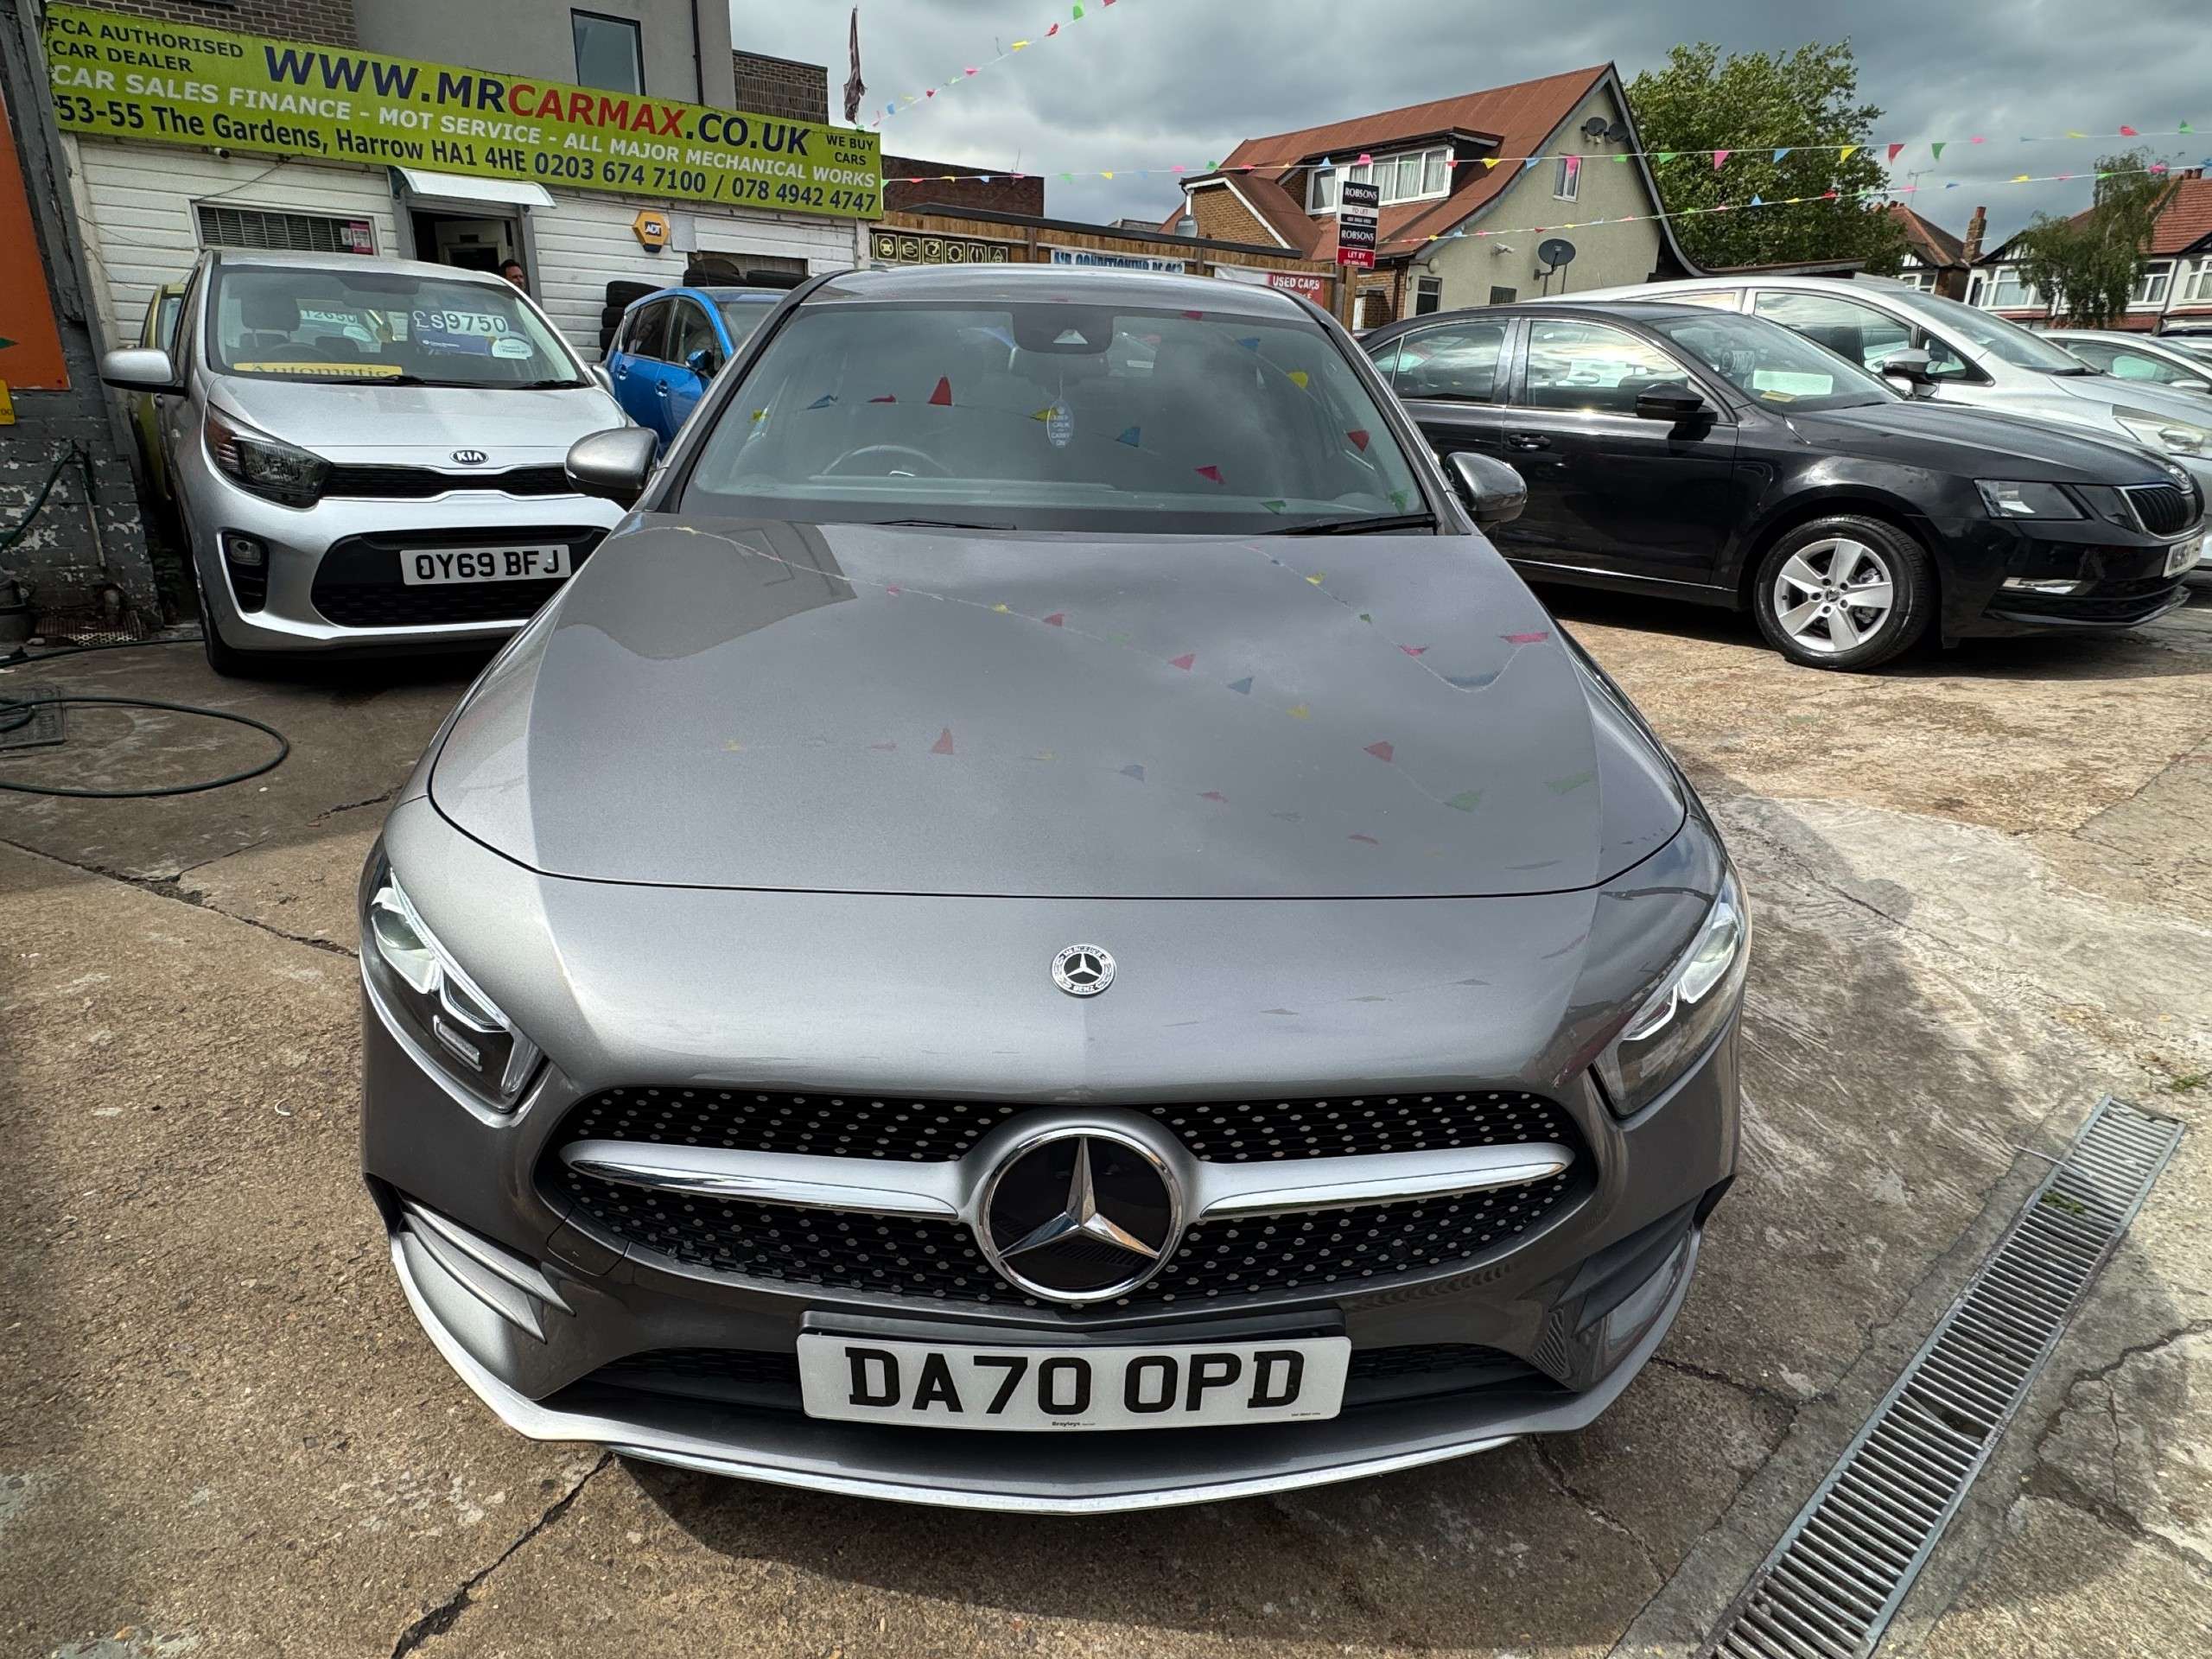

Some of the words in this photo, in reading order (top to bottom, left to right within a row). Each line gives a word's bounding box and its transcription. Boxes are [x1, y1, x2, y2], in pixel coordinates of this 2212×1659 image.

[48, 17, 92, 37] FCA
[99, 24, 243, 58] AUTHORISED
[53, 40, 99, 60] CAR
[107, 48, 194, 73] DEALER
[264, 46, 812, 156] WWW.MRCARMAX.CO.UK
[52, 65, 116, 91] CAR
[125, 73, 219, 104] SALES
[229, 87, 352, 120] FINANCE
[379, 107, 434, 130] MOT
[440, 115, 541, 144] SERVICE
[564, 133, 602, 153] ALL
[610, 138, 678, 162] MAJOR
[686, 149, 806, 180] MECHANICAL
[813, 165, 875, 188] WORKS
[56, 95, 145, 130] 53-55
[151, 105, 205, 136] The
[213, 113, 328, 155] Gardens,
[336, 128, 423, 160] Harrow
[432, 139, 477, 167] HA1
[485, 147, 527, 172] 4HE
[535, 152, 594, 180] 0203
[603, 162, 645, 186] 674
[653, 167, 706, 194] 7100
[713, 175, 724, 199] /
[732, 177, 769, 200] 078
[776, 183, 823, 207] 4942
[830, 189, 876, 213] 4747
[826, 135, 845, 149] WE
[849, 137, 874, 151] BUY
[834, 151, 867, 166] CARS
[1344, 187, 1377, 200] ROBSONS
[645, 224, 661, 235] ADT
[1341, 230, 1374, 242] ROBSONS
[1272, 276, 1296, 288] USED
[1298, 277, 1320, 289] CARS
[456, 451, 484, 462] KIA
[415, 552, 495, 580] OY69
[503, 550, 559, 576] BFJ
[844, 1346, 1092, 1415] DA70
[1123, 1350, 1305, 1414] OPD
